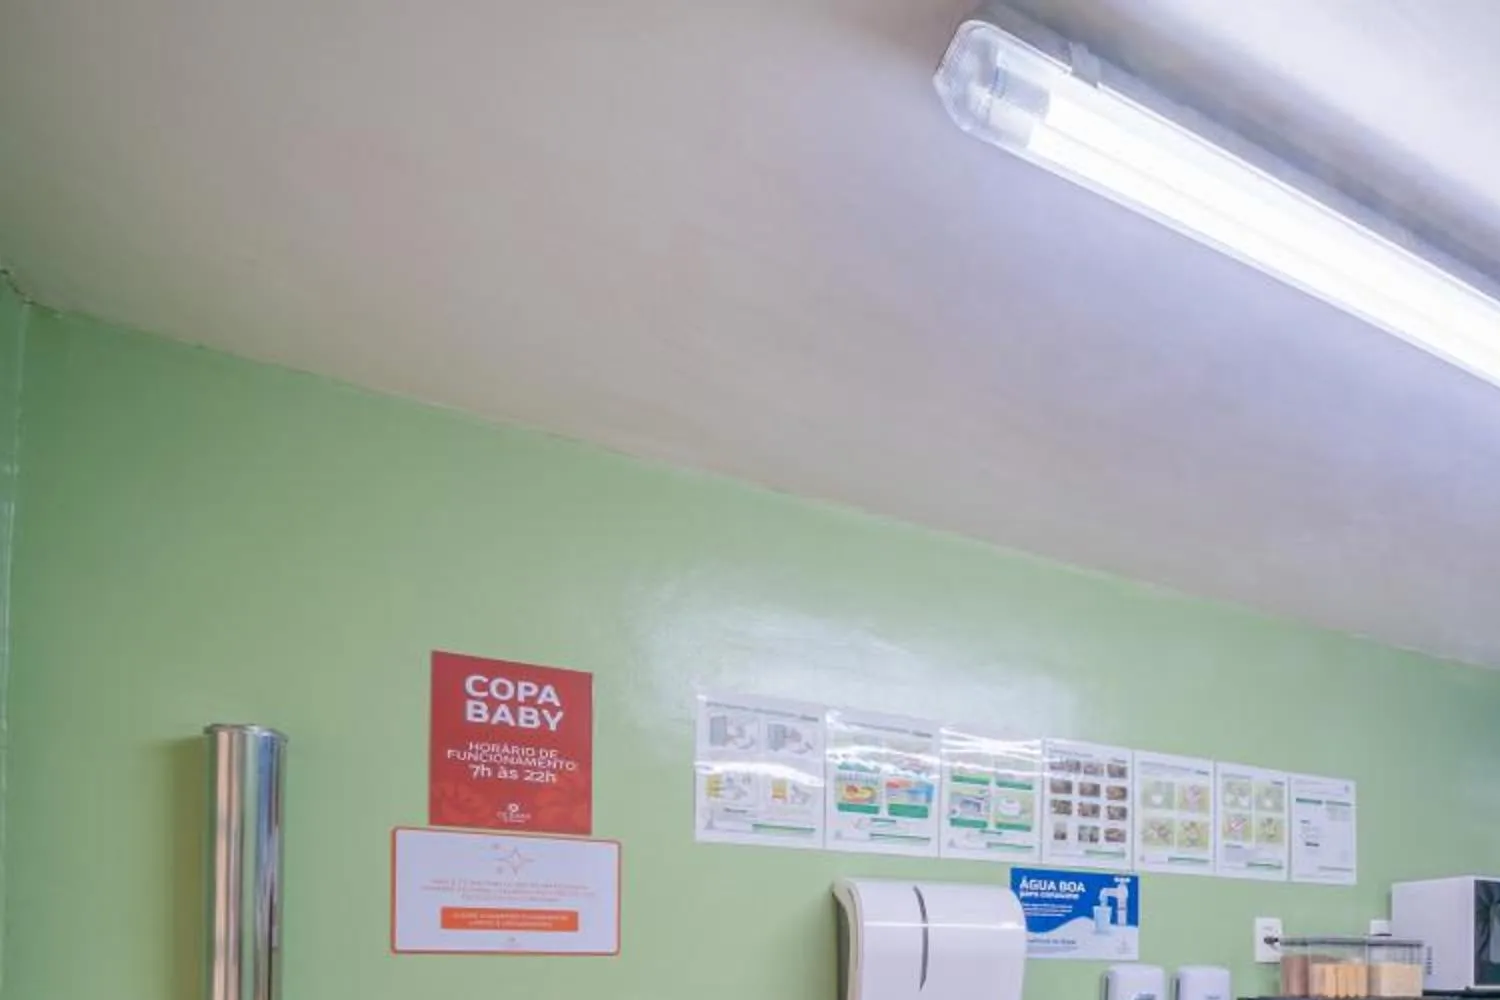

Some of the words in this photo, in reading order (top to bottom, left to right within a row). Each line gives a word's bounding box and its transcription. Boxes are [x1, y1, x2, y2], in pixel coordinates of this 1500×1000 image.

[465, 675, 561, 706] COPA
[465, 700, 563, 731] BABY
[540, 748, 559, 759] DE
[469, 763, 492, 779] 7h
[497, 765, 519, 780] às
[523, 769, 557, 783] 22h
[1020, 876, 1057, 891] ÁGUA
[1060, 881, 1086, 892] BOA
